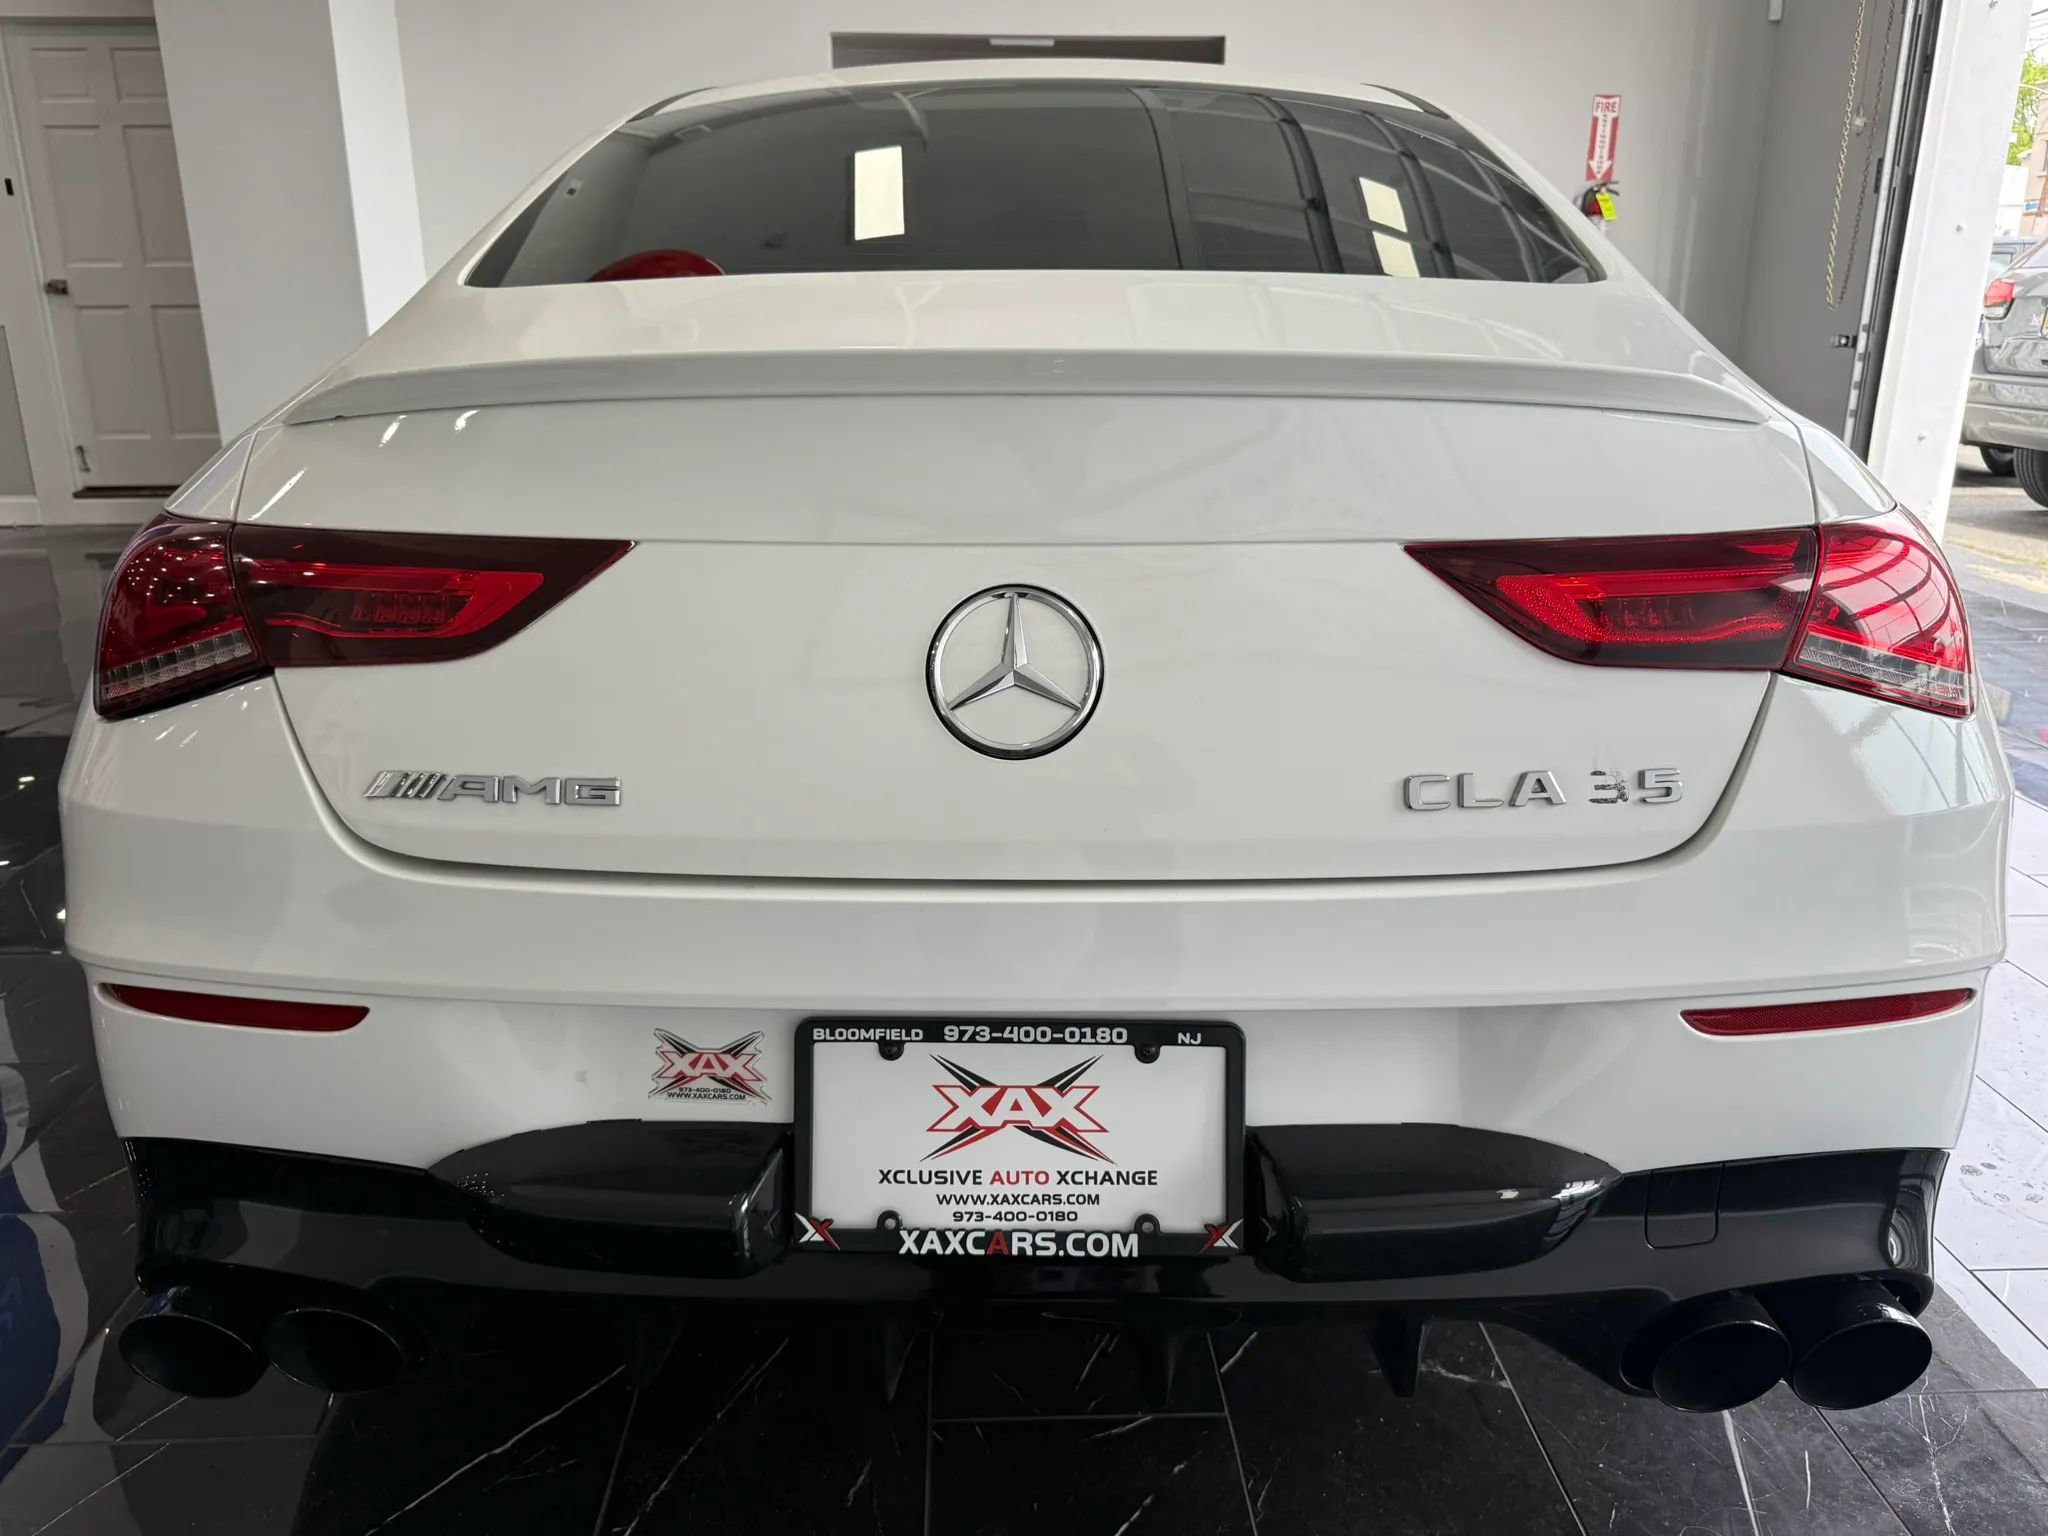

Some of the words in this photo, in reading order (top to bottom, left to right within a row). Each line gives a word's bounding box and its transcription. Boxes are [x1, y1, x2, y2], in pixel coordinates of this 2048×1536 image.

[1595, 101, 1617, 113] FIRE
[1403, 770, 1567, 811] CLA
[813, 1027, 924, 1041] BLOOMFIELD
[943, 1025, 1129, 1044] 973-400-0180
[1177, 1032, 1203, 1045] NJ
[656, 1051, 763, 1082] XAX
[667, 1092, 746, 1101] WWW.XAXCARS.COM
[926, 1084, 1110, 1133] XAX
[878, 1169, 983, 1186] XCLUSIVE
[989, 1170, 1050, 1186] AUTO
[1056, 1170, 1158, 1186] XCHANGE
[935, 1193, 1100, 1206] WWW.XAXCARS.COM
[952, 1210, 1079, 1223] 973-400-0180
[897, 1229, 1140, 1258] XAXCARS.COM
